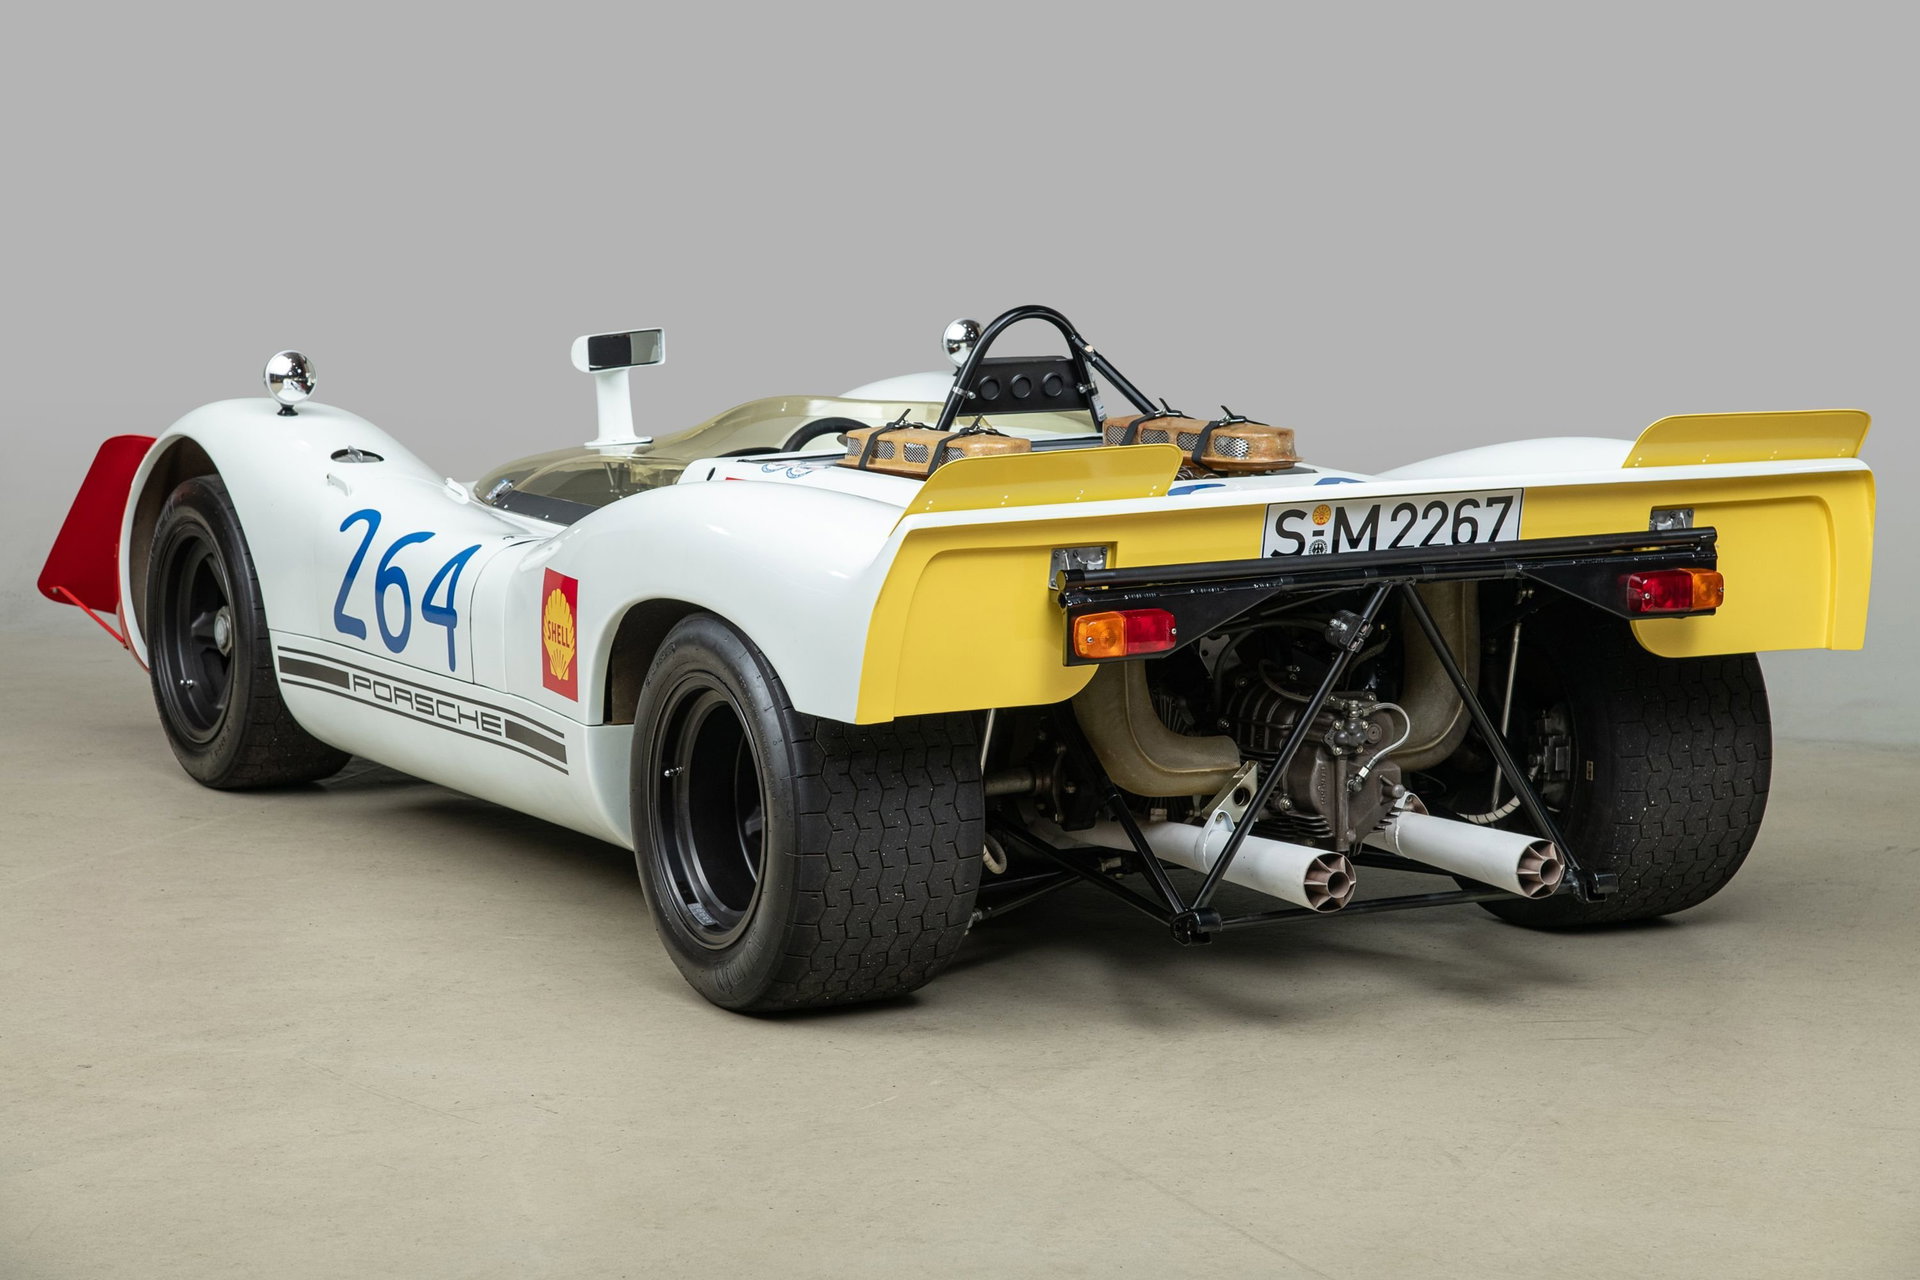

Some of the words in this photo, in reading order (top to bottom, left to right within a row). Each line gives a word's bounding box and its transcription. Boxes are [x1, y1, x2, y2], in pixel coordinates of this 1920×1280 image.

[334, 508, 482, 672] 264
[547, 620, 570, 648] SHELL
[353, 674, 502, 736] PORSCHE
